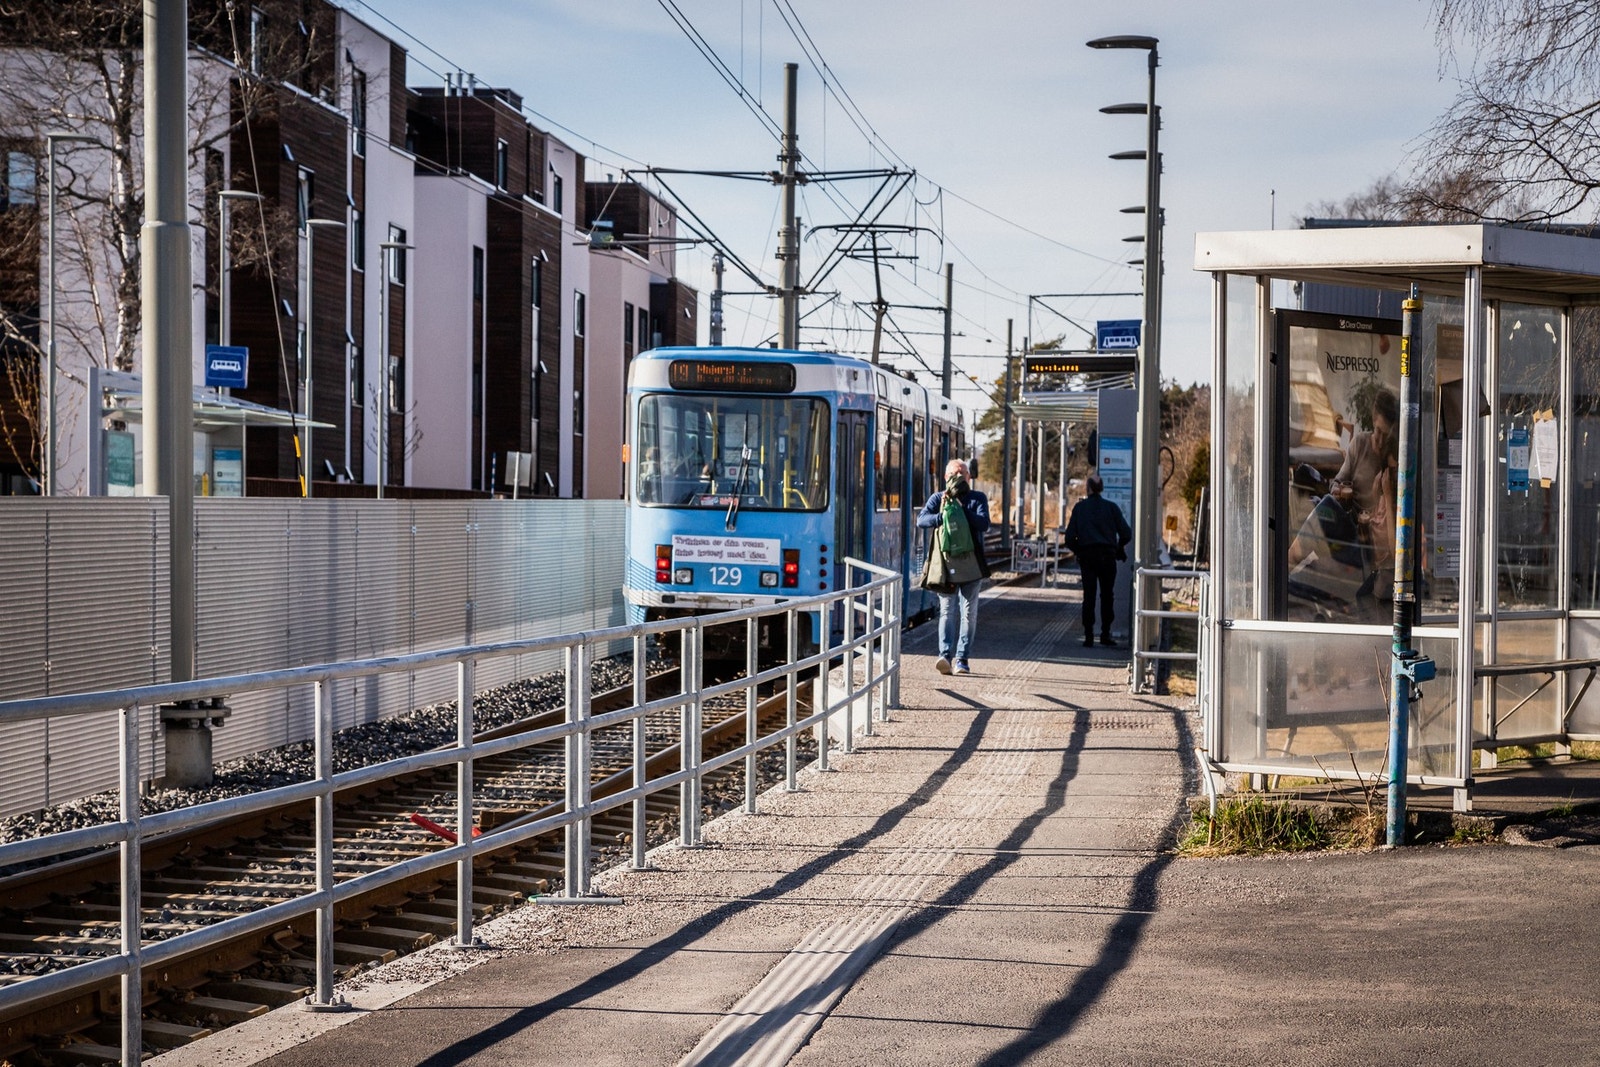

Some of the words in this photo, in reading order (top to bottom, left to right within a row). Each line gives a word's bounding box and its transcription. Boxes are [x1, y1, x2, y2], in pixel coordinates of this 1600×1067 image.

[1346, 321, 1356, 329] Clear
[1357, 321, 1373, 330] Channel
[1325, 352, 1379, 373] NESPRESSO
[709, 566, 742, 587] 129
